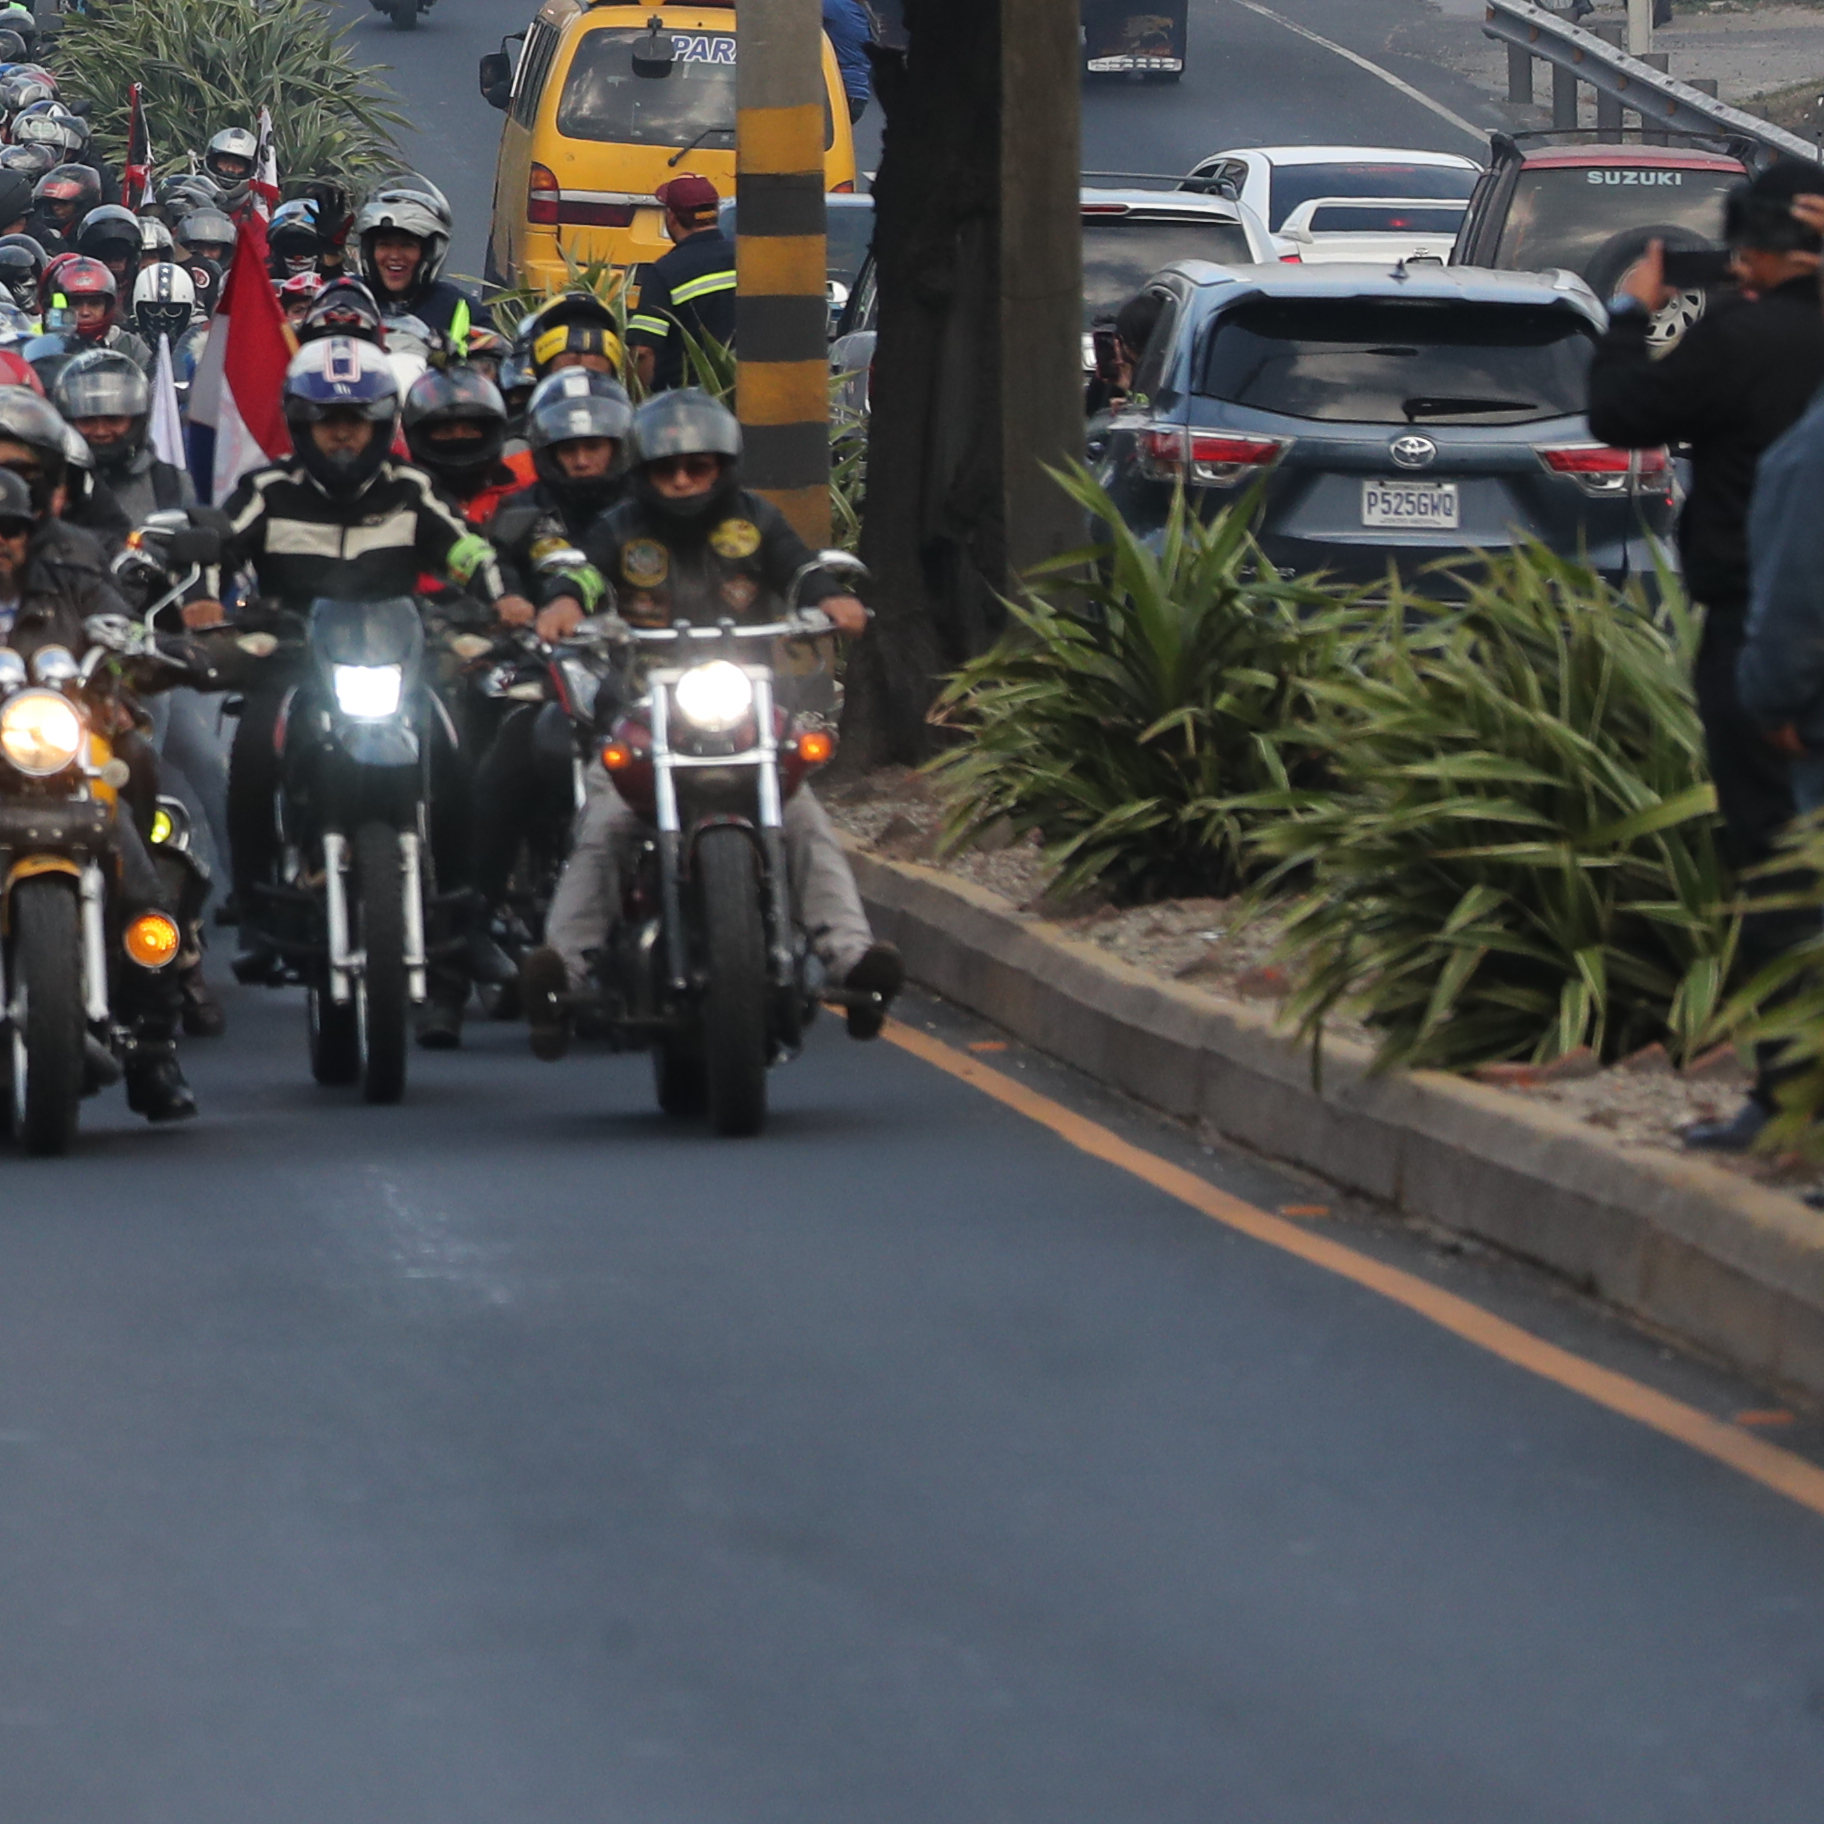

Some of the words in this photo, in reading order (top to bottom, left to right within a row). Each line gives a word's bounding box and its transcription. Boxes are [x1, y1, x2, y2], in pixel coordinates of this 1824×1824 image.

[671, 35, 737, 64] PAR
[1587, 170, 1682, 187] SUZUKI
[1367, 491, 1454, 517] P525GWQ
